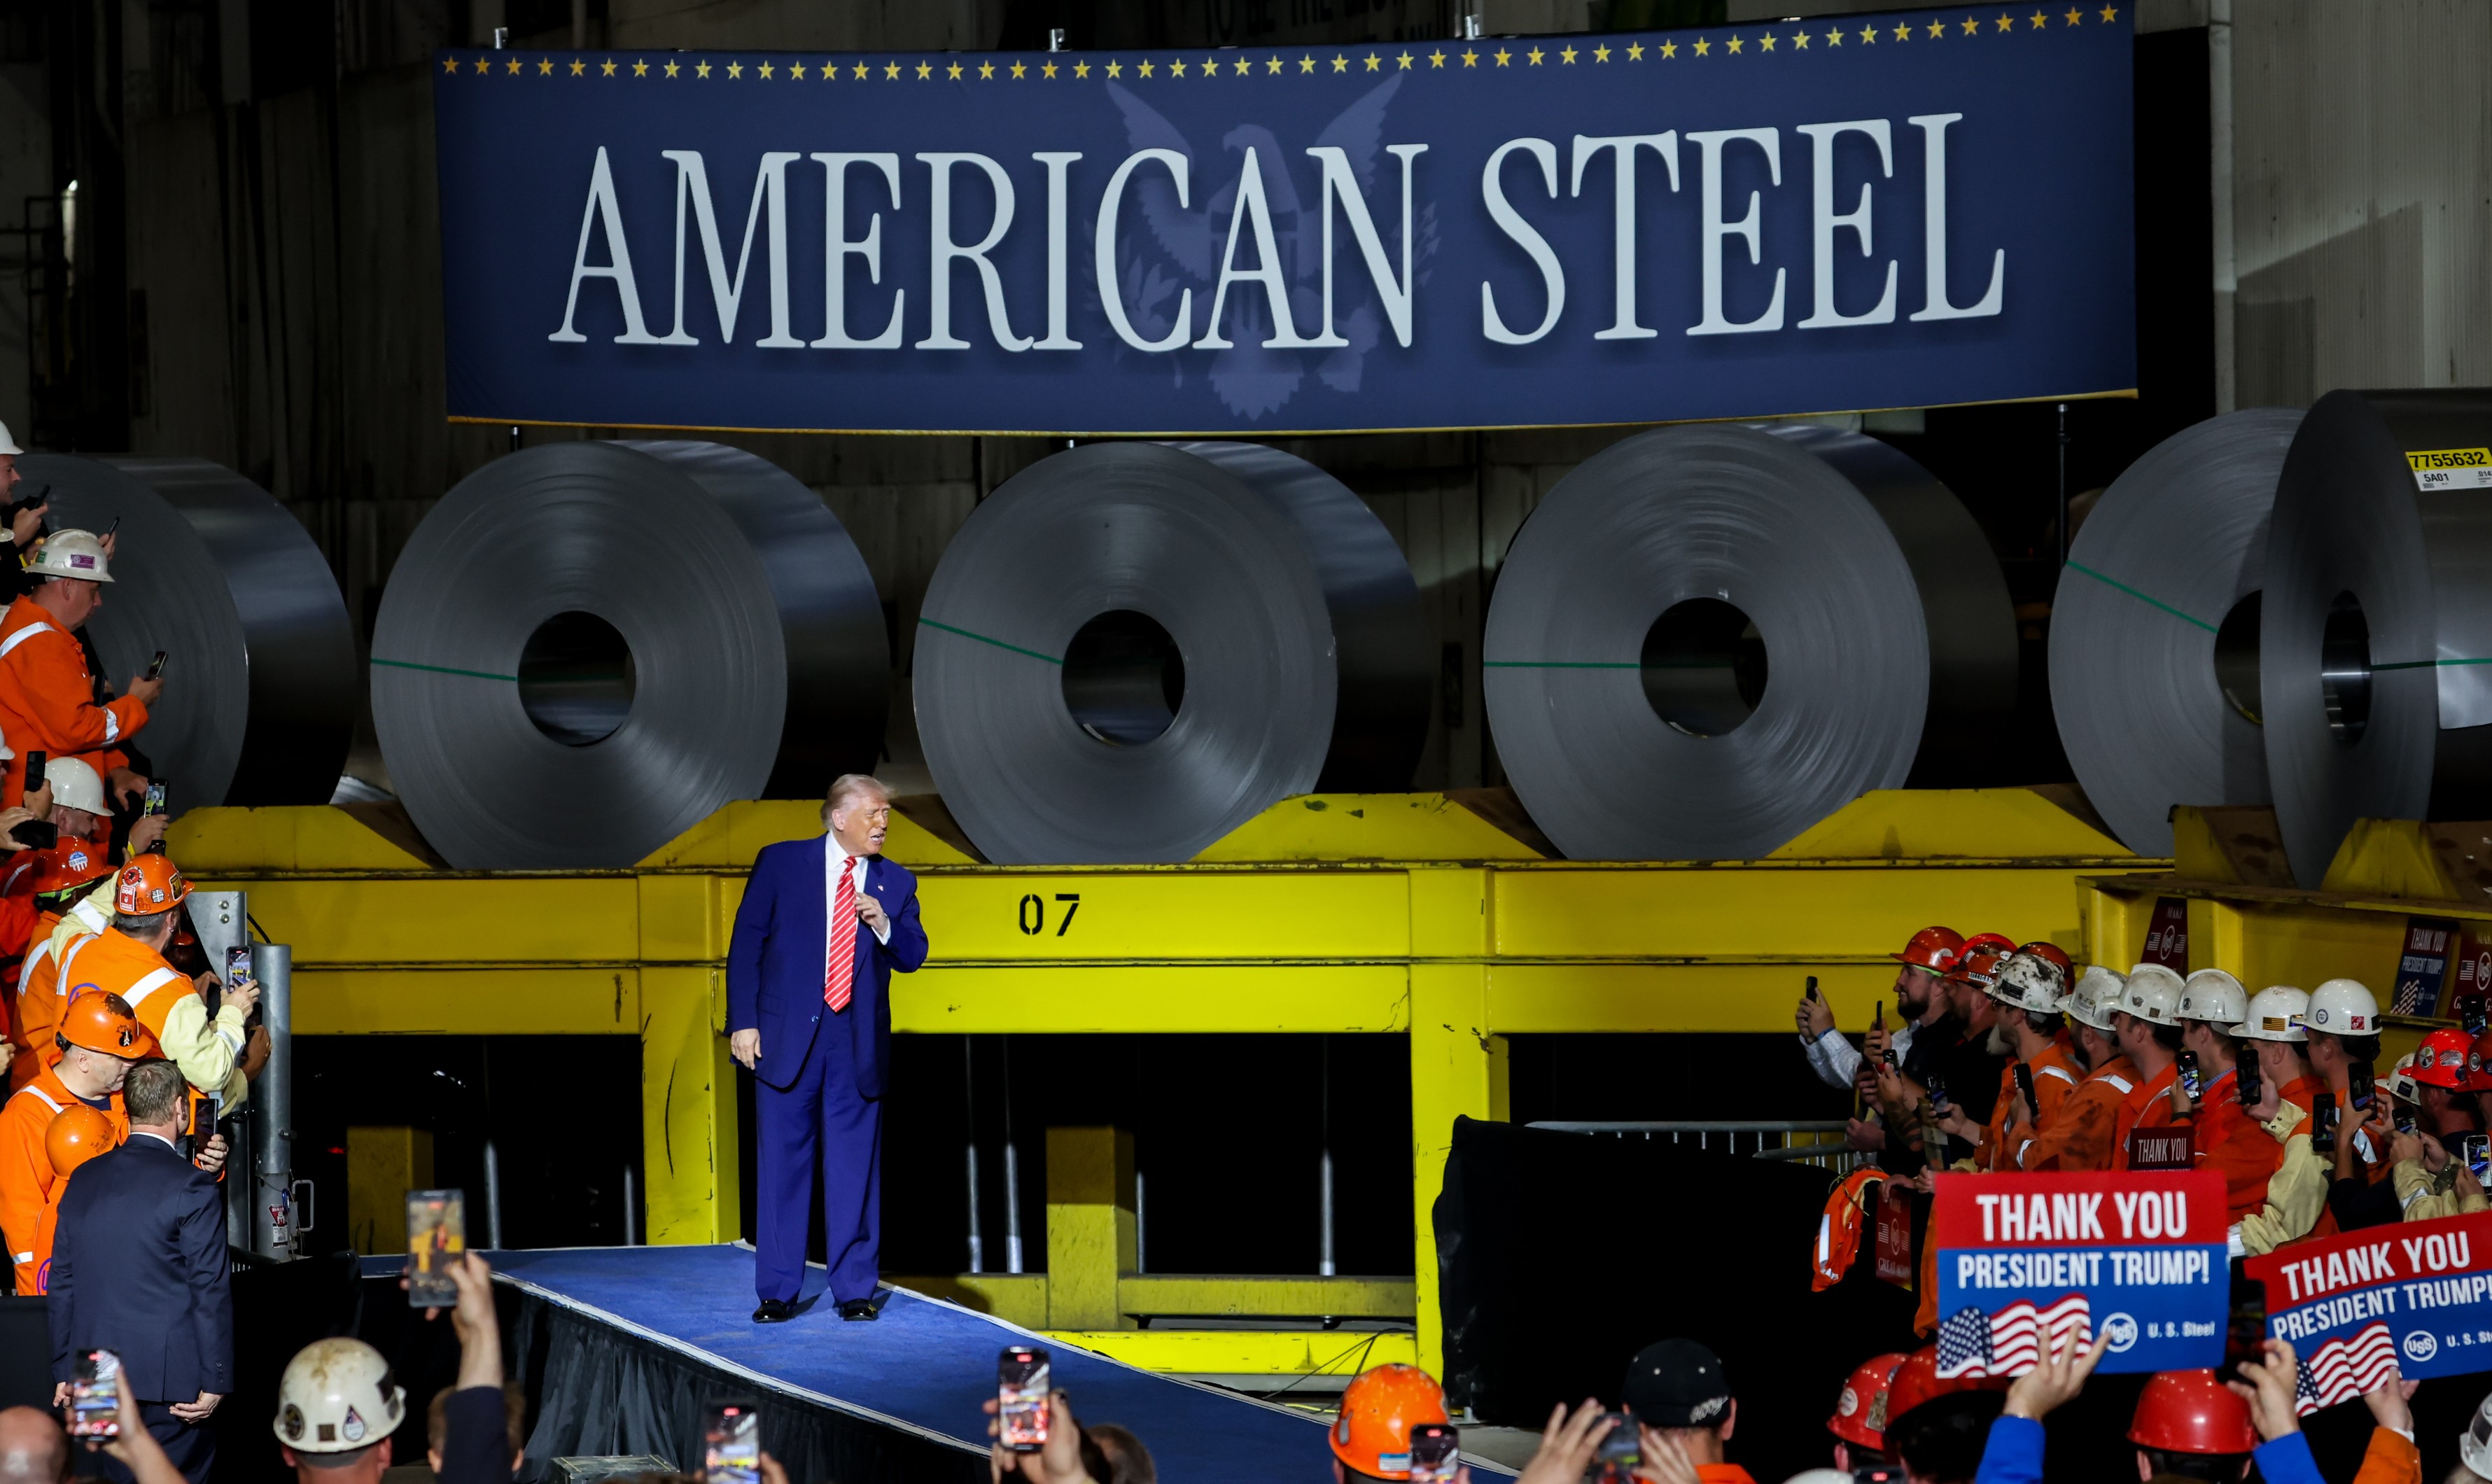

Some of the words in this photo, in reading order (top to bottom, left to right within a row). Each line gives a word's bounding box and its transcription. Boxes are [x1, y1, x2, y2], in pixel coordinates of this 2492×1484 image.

[548, 144, 1429, 353] AMERICAN
[1482, 112, 2005, 346] STEEL
[2409, 451, 2487, 468] 7755632
[2424, 472, 2449, 482] 5A01
[1019, 893, 1080, 937] 07
[2412, 928, 2432, 951] THANK
[2432, 931, 2447, 952] YOU
[2401, 955, 2428, 973] PRESIDENT
[2138, 1138, 2169, 1163] THANK
[2171, 1137, 2187, 1162] YOU
[1976, 1192, 2104, 1242] THANK
[2113, 1191, 2188, 1239] YOU
[1957, 1252, 2104, 1289] PRESIDENT
[2109, 1250, 2210, 1286] TRUMP!
[2280, 1241, 2395, 1301] THANK
[2401, 1231, 2471, 1274] YOU
[2272, 1287, 2395, 1340] PRESIDENT
[2147, 1322, 2162, 1338] U.
[2165, 1321, 2180, 1338] S.
[2182, 1320, 2216, 1338] Steel
[2446, 1334, 2460, 1348] U.
[2462, 1332, 2476, 1345] S.
